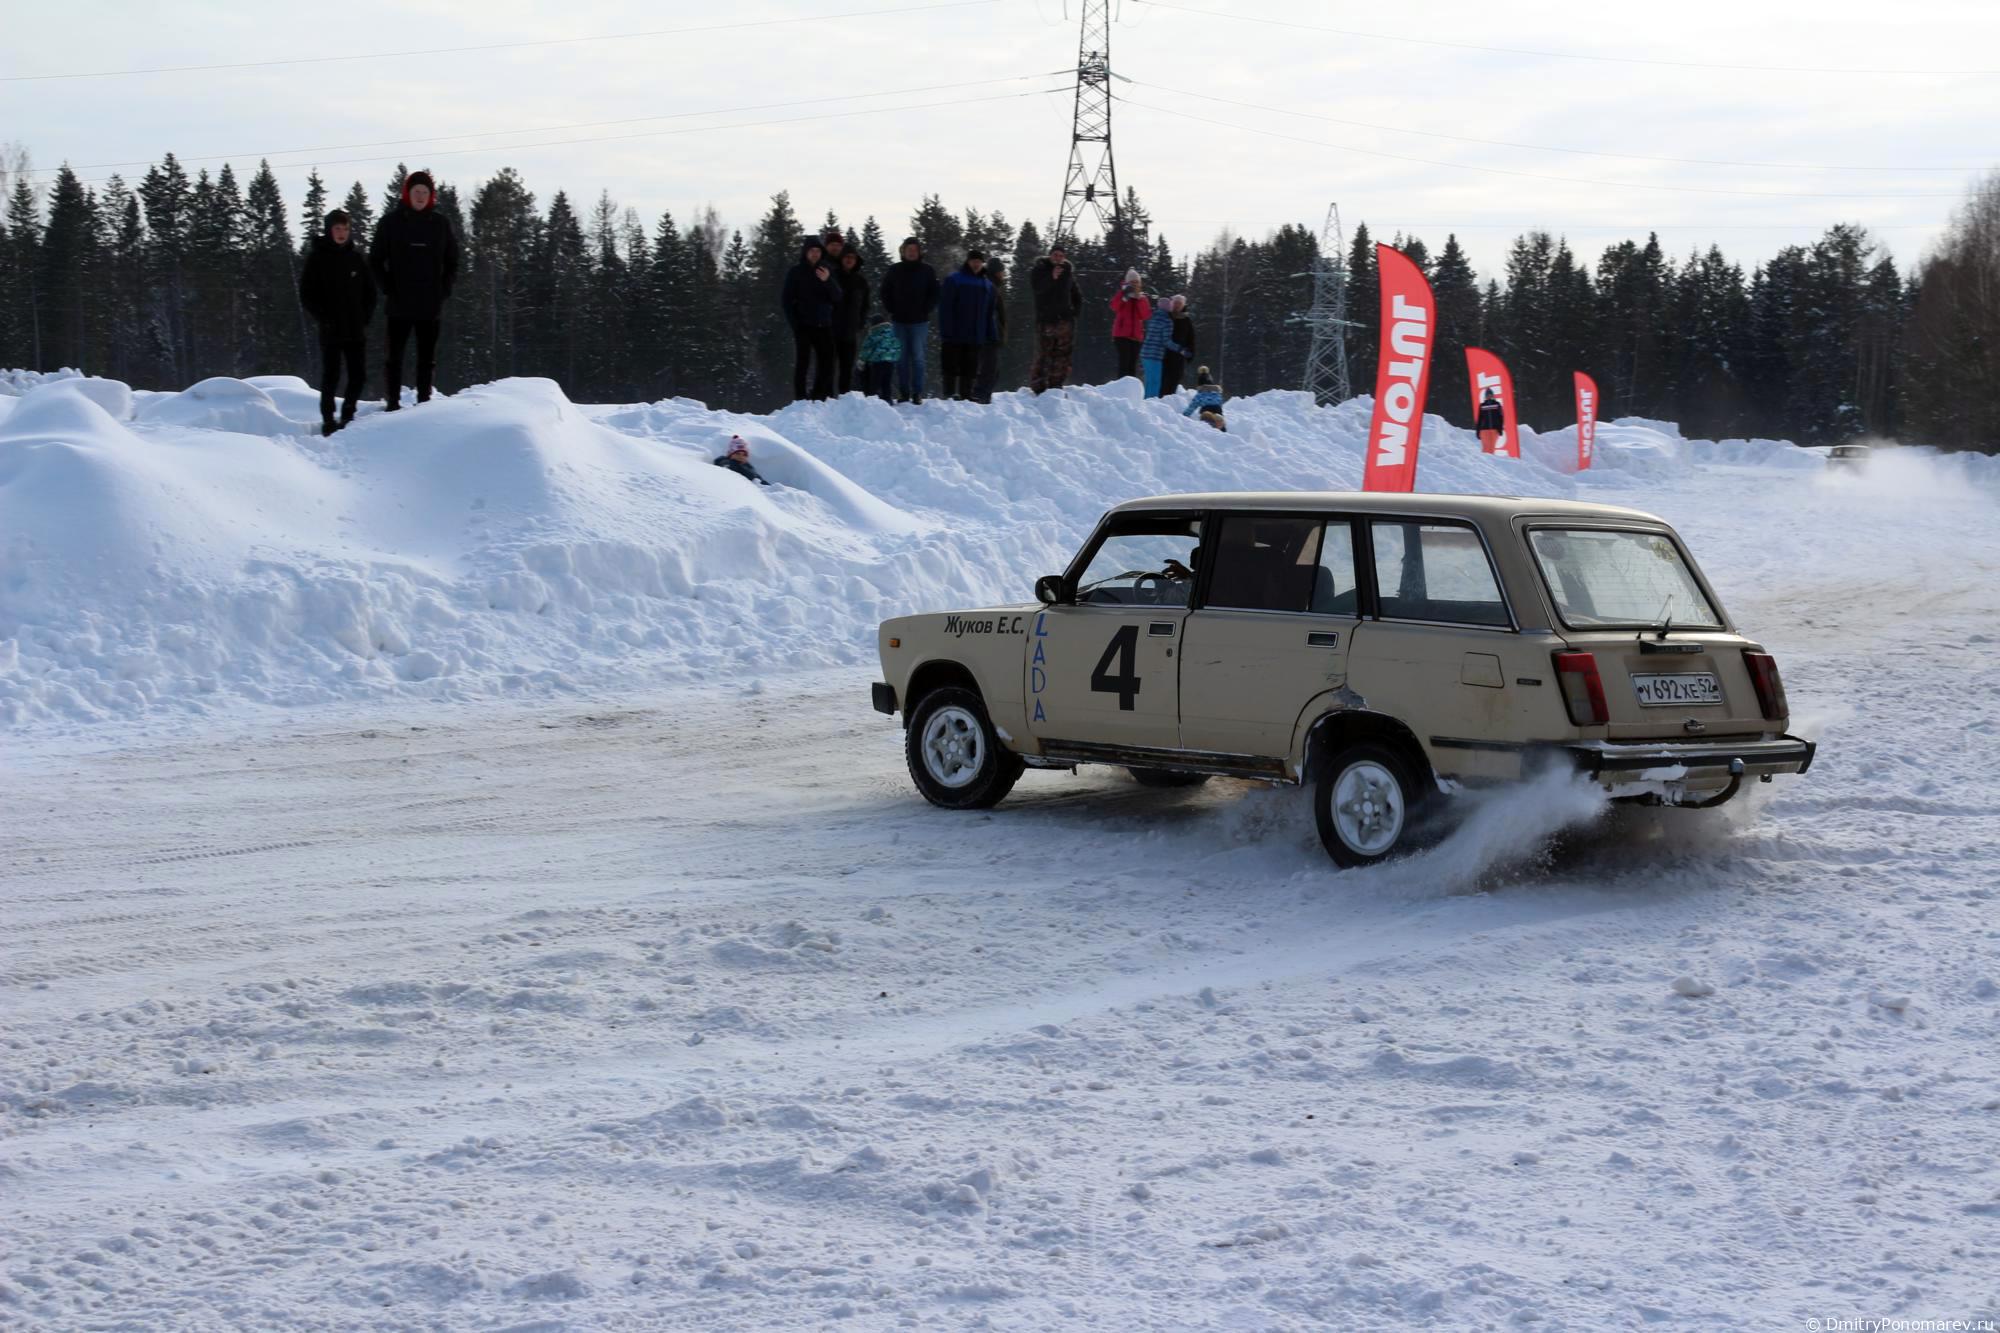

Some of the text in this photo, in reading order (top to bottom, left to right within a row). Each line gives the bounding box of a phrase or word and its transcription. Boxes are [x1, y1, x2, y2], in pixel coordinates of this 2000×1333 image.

[944, 615, 993, 638] Жуков
[1032, 613, 1048, 722] LADA
[1091, 625, 1141, 711] 4
